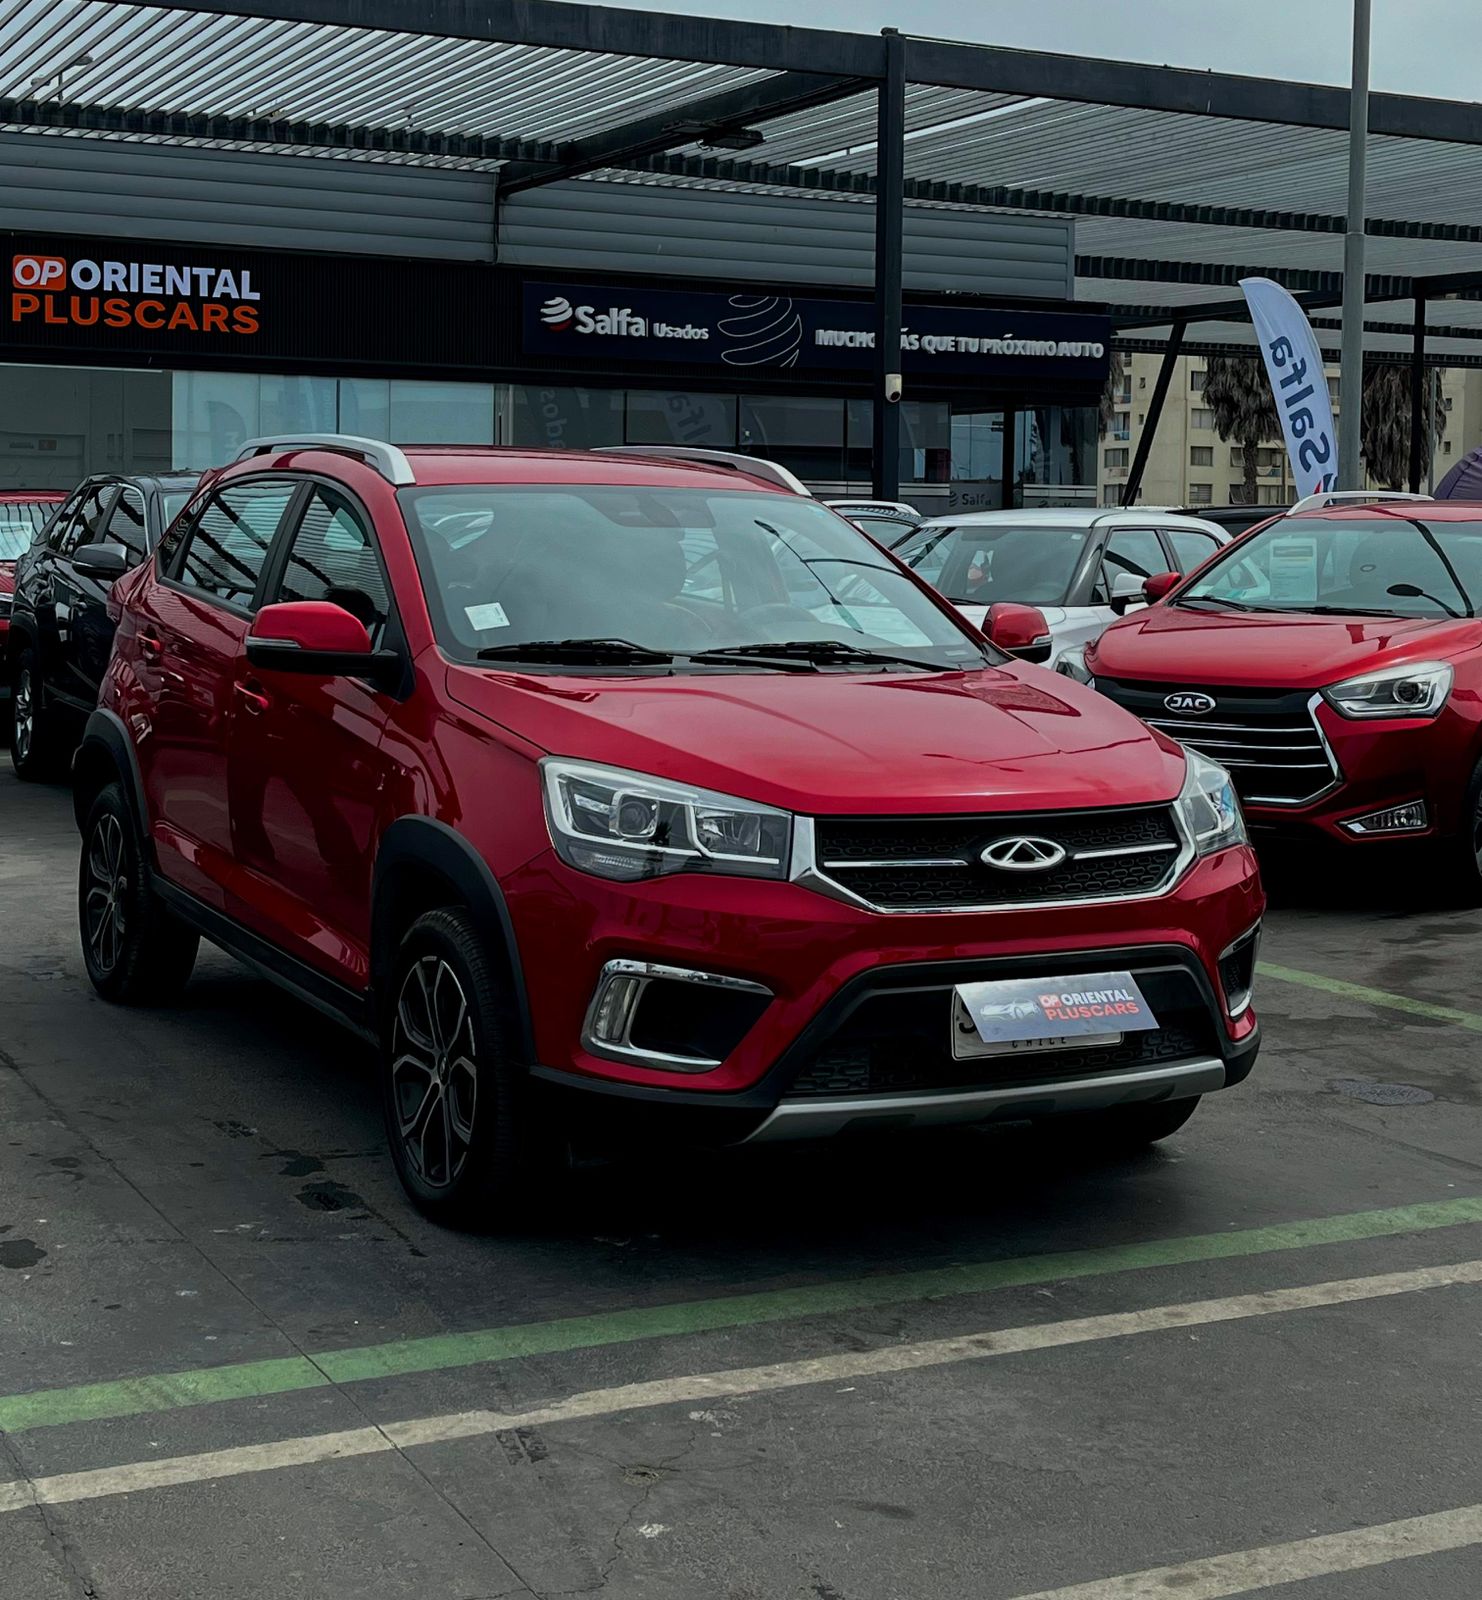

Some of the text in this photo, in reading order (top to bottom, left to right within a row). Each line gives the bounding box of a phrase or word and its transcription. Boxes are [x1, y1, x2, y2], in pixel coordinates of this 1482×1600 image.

[14, 258, 261, 301] OP ORIENTAL
[12, 292, 260, 335] PLUSCARS
[574, 304, 710, 340] Salfa Usados
[900, 327, 920, 350] ÁS
[920, 335, 955, 354] QUE
[955, 336, 979, 353] TU
[980, 333, 1057, 357] PRÓXIMO
[1057, 341, 1105, 359] AUTO
[1169, 696, 1208, 709] JAC
[1045, 1001, 1140, 1021] PLUSCARS
[1061, 988, 1135, 1006] ORIENTAL
